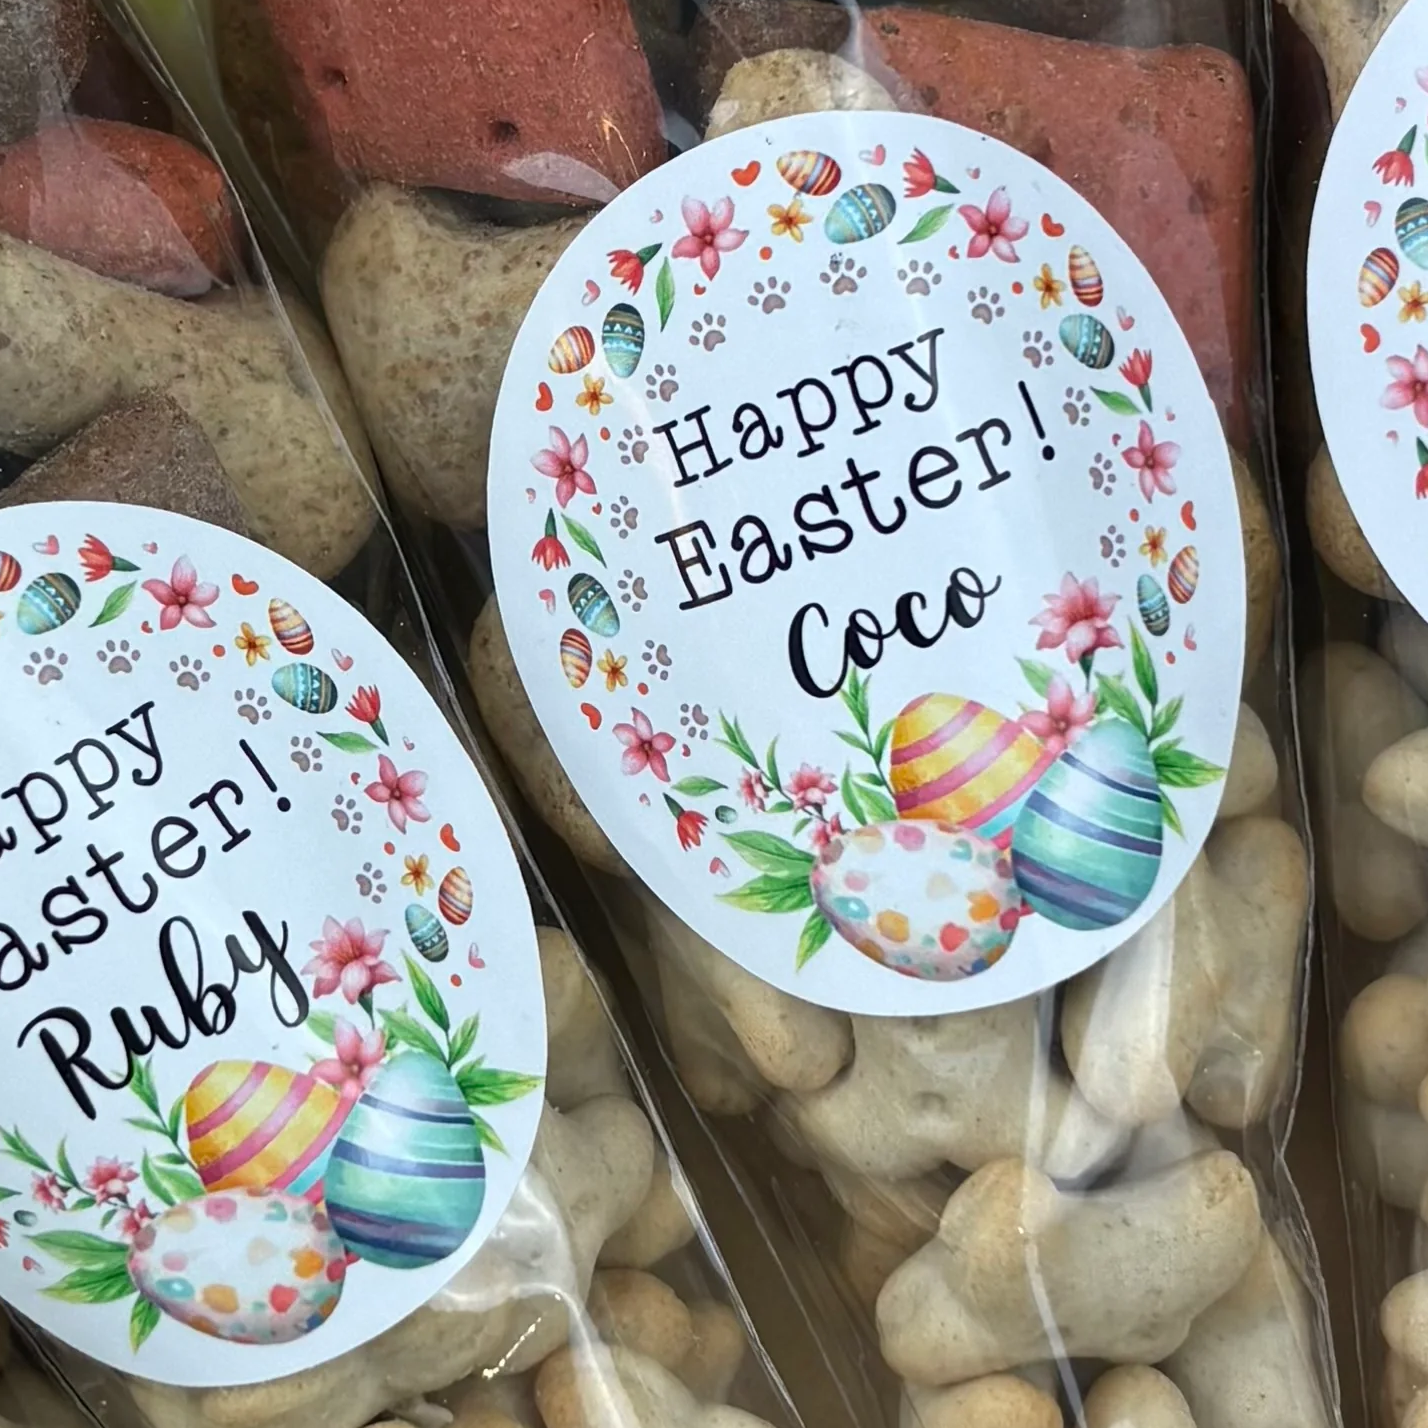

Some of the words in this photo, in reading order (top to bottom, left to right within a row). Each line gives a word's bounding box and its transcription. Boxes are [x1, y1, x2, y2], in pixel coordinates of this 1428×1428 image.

[653, 328, 944, 487] Happy
[654, 381, 1055, 610] Easter!
[788, 567, 1002, 698] Coco
[17, 910, 310, 1120] Ruby
